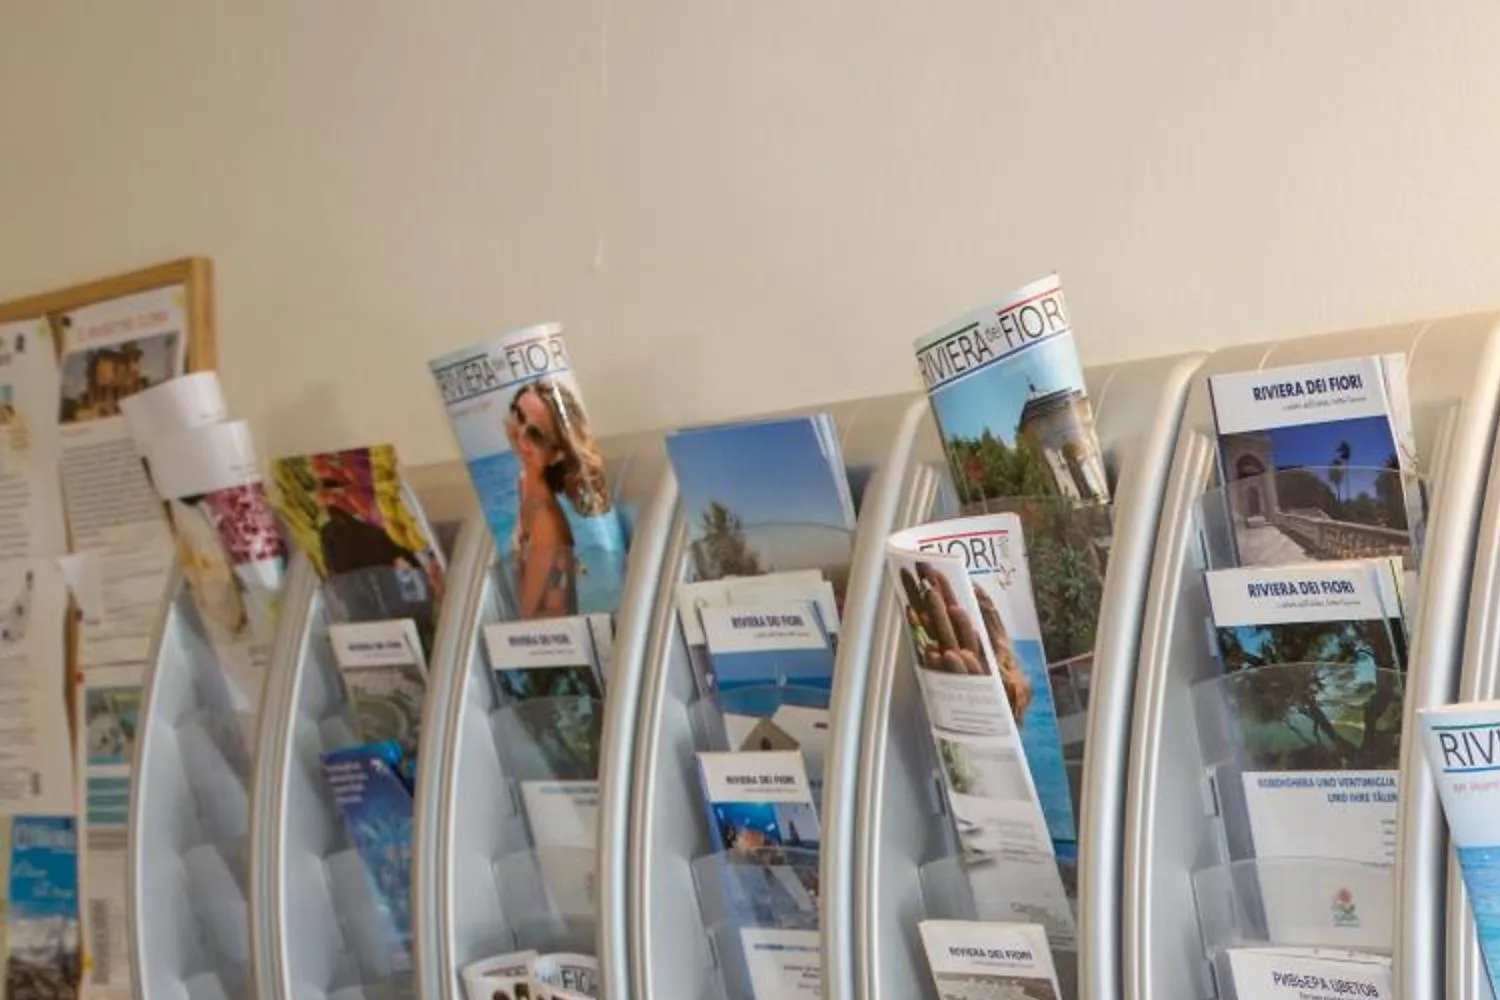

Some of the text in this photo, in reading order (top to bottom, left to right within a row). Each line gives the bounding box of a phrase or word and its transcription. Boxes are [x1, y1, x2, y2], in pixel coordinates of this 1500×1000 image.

[917, 329, 993, 383] RIVIERA
[1252, 373, 1363, 401] RIVIERA DEI FIORI
[1248, 578, 1356, 598] RIVIERA DEI FIORI
